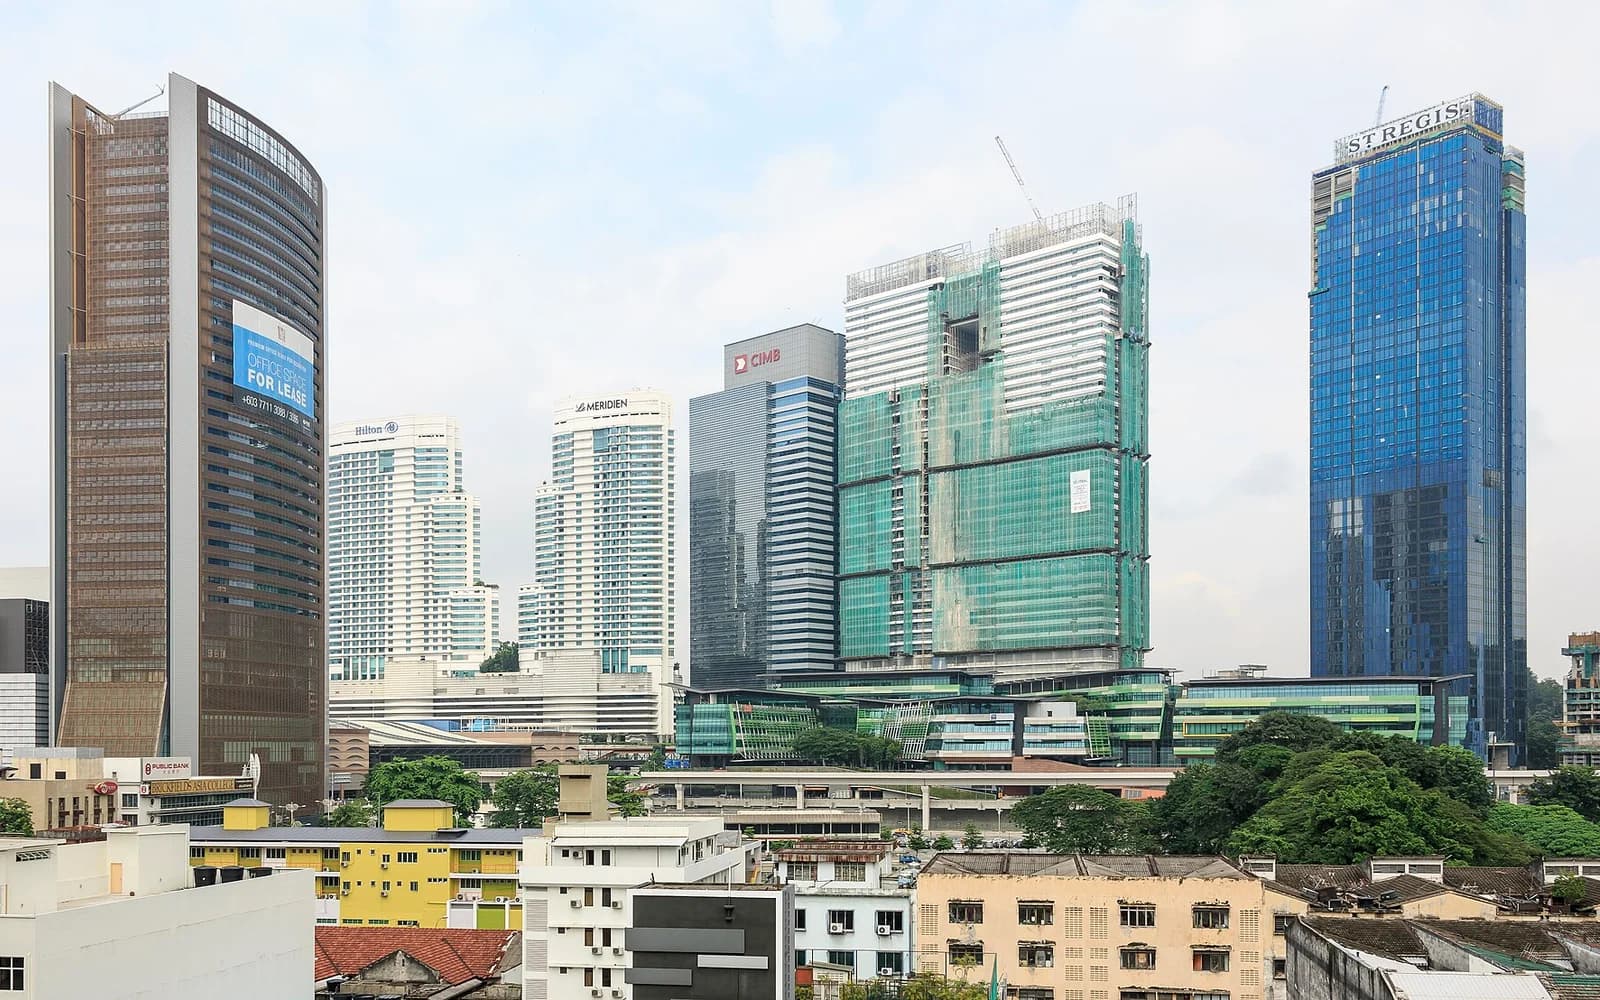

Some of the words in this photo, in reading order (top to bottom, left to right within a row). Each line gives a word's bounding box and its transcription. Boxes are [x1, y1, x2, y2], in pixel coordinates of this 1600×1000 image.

[1382, 103, 1459, 142] REGIS
[751, 348, 781, 367] CIMB
[247, 353, 282, 378] OFFICE
[283, 367, 307, 393] SPACE
[247, 368, 275, 391] FOR
[277, 379, 307, 408] LEASE
[242, 395, 258, 408] +603
[259, 399, 272, 412] 7711
[586, 398, 628, 412] MERIDIEN
[355, 425, 383, 436] Hilton
[152, 780, 192, 794] BRICKFIELDS
[192, 780, 208, 791] ASIA
[208, 779, 233, 791] COLLEGE
